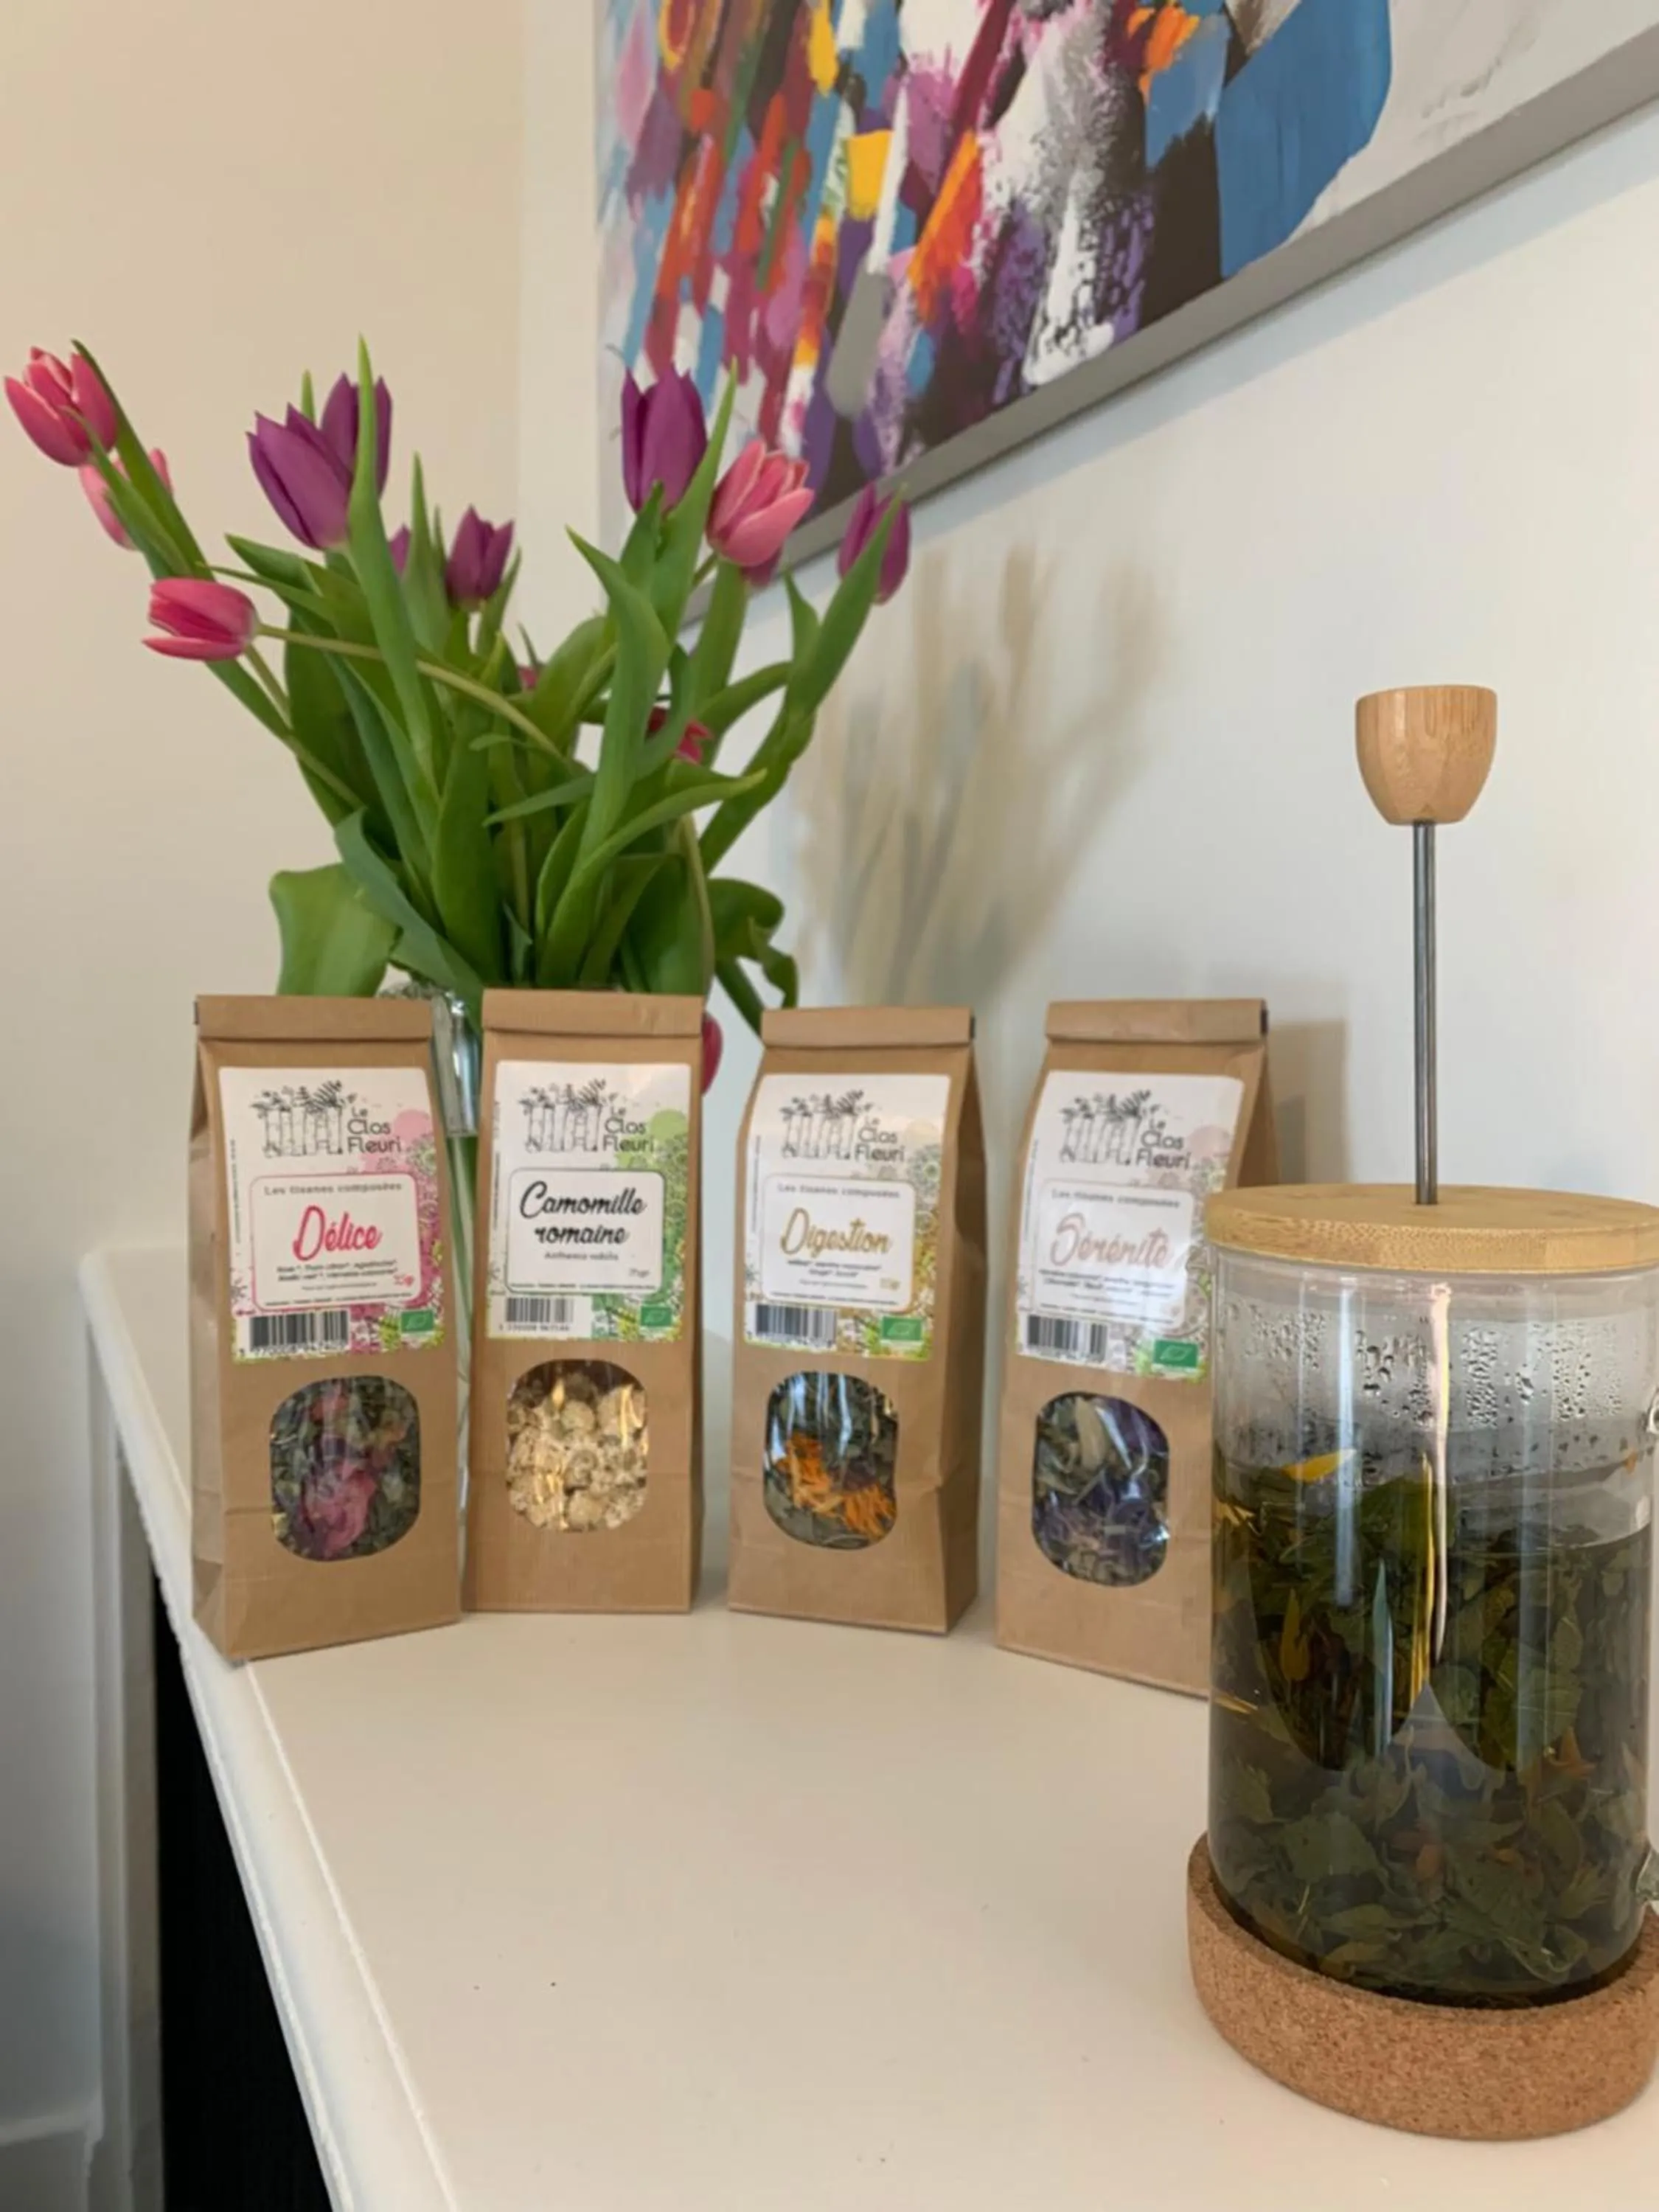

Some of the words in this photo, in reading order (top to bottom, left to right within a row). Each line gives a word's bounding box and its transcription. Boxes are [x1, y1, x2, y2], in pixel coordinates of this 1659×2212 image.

[352, 1106, 368, 1117] Le
[610, 1106, 626, 1117] Le
[347, 1119, 391, 1135] Clos
[605, 1116, 647, 1135] Clos
[864, 1115, 880, 1127] Le
[1149, 1118, 1166, 1130] Le
[603, 1134, 654, 1153] Fleuri
[858, 1127, 897, 1144] Clos
[1141, 1130, 1184, 1150] Clos
[347, 1136, 401, 1154] Fleuri
[855, 1144, 905, 1162] Fleuri
[1135, 1147, 1192, 1171] Fleuri
[264, 1186, 285, 1195] Les
[290, 1184, 333, 1194] tisanes
[338, 1182, 402, 1194] composées
[777, 1183, 796, 1193] Les
[799, 1184, 838, 1194] tisanes
[520, 1180, 647, 1219] Camomille
[293, 1205, 383, 1261] Délice
[535, 1225, 630, 1245] romaine
[780, 1207, 893, 1258] Digestion
[1050, 1212, 1171, 1268] Sérénité
